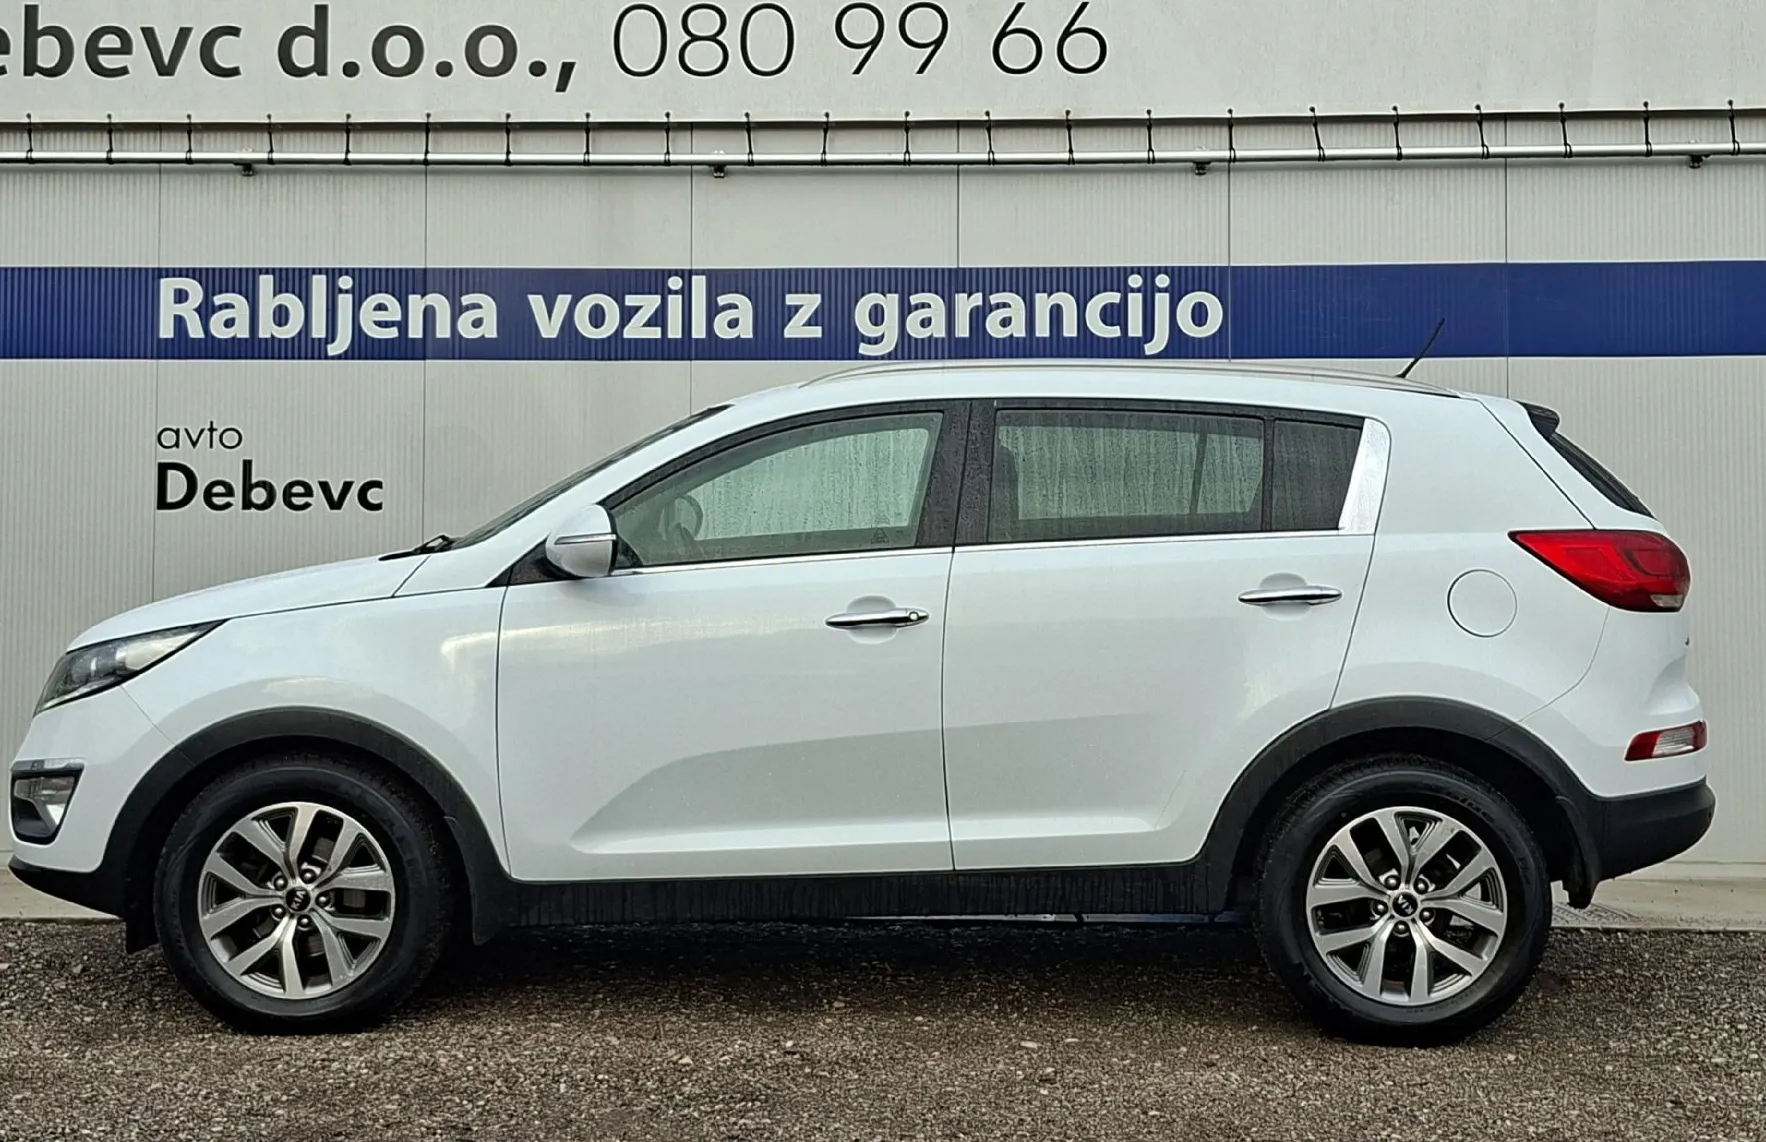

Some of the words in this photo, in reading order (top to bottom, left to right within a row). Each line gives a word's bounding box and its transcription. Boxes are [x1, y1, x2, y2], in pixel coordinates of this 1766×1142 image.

[0, 4, 242, 79] bevc
[277, 4, 577, 93] d.o.o.,
[613, 3, 795, 78] 080
[834, 1, 949, 76] 99
[992, 1, 1108, 76] 66
[159, 274, 498, 357] Rabljena
[527, 274, 754, 339] vozila
[783, 293, 823, 339] z
[854, 273, 1224, 357] garancijo
[156, 420, 243, 450] avto
[156, 458, 384, 512] Debevc
